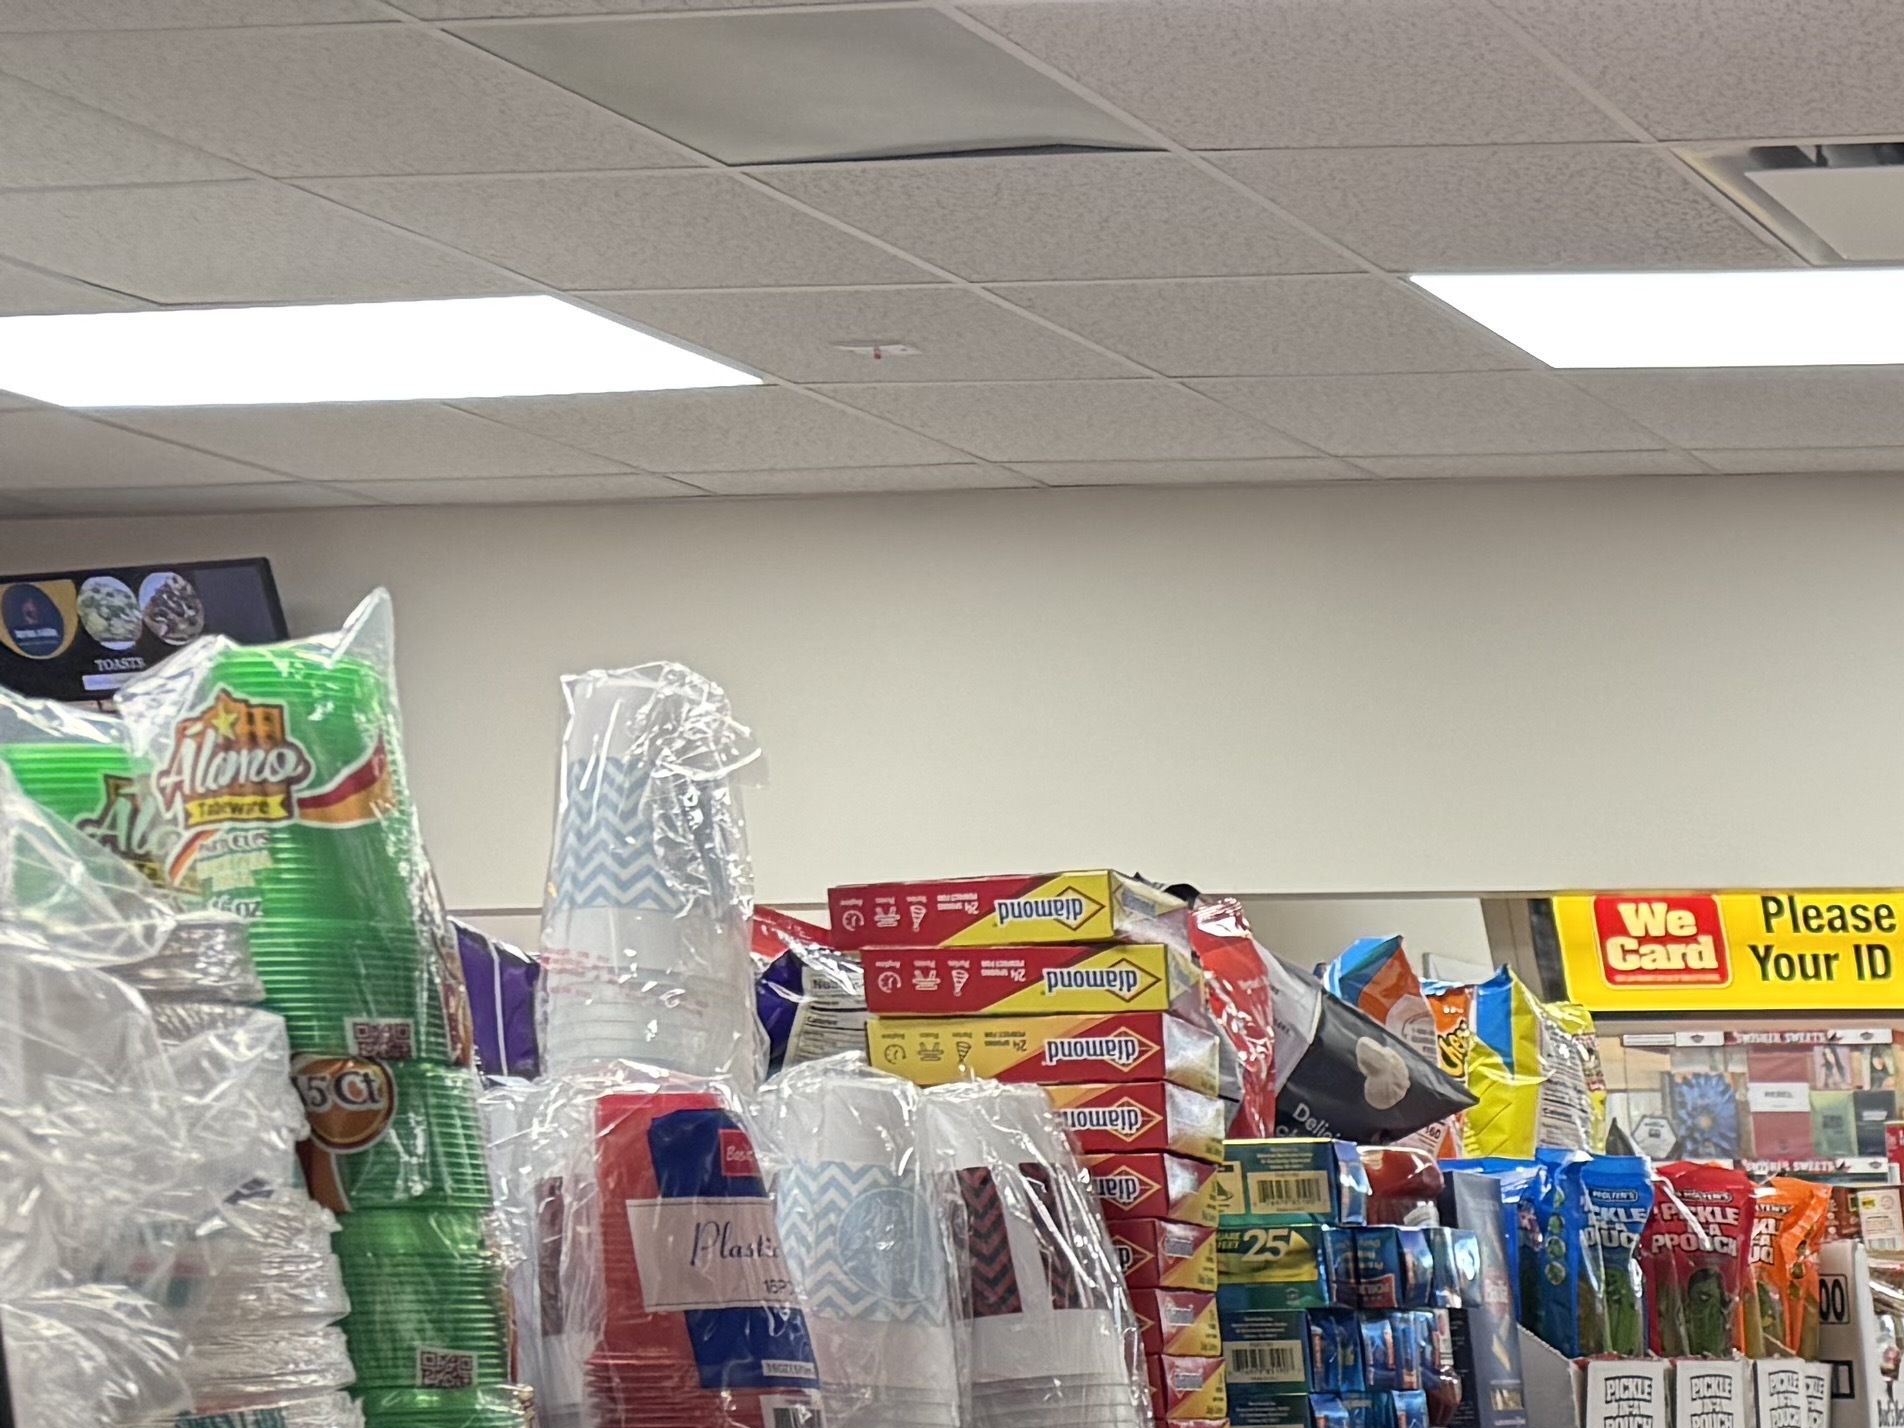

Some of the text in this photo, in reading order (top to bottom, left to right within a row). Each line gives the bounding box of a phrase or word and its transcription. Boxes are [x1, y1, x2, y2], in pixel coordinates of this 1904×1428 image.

[996, 896, 1085, 925] diamond
[1616, 902, 1698, 938] We
[1760, 895, 1897, 935] Please
[1605, 935, 1720, 974] Card
[1750, 943, 1841, 983] Your
[1854, 944, 1891, 981] ID
[1044, 967, 1139, 992] diamond
[1046, 1037, 1137, 1065] diamond
[1243, 1229, 1290, 1262] 25
[1605, 1376, 1652, 1403] PICKLE
[1690, 1375, 1733, 1401] PICKLE
[1769, 1371, 1800, 1397] PICKLE
